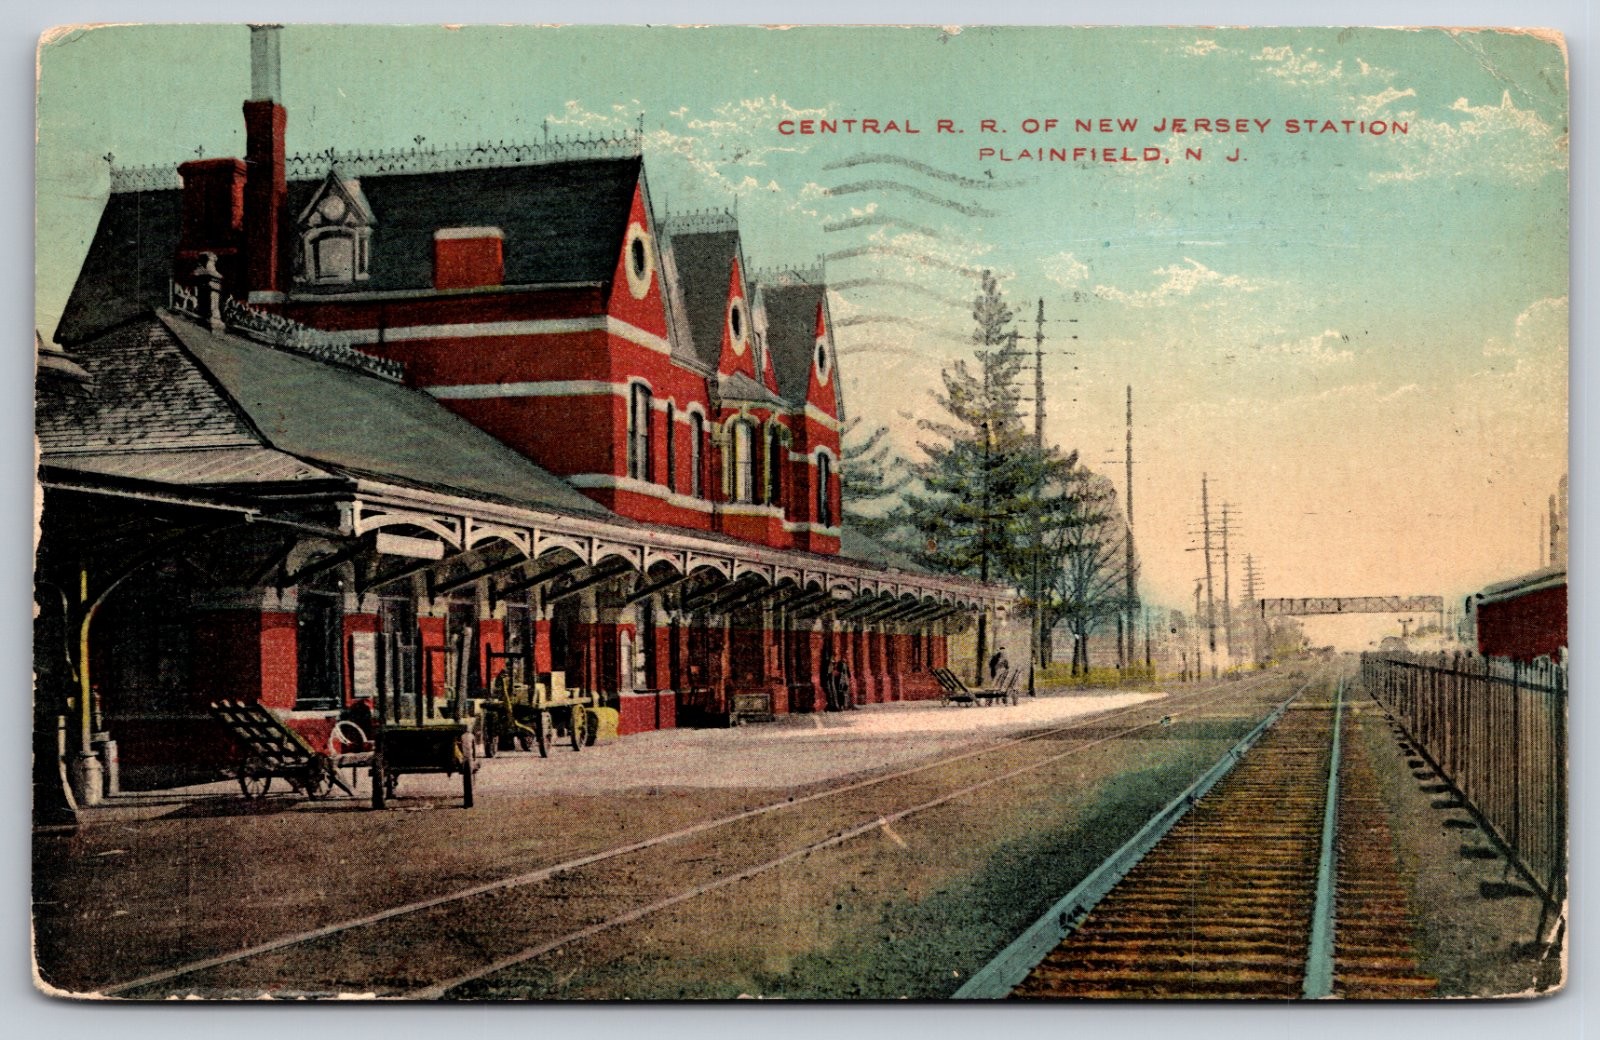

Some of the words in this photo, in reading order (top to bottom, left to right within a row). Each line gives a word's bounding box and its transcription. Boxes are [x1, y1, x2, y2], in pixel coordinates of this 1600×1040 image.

[777, 118, 921, 136] CENTRAL
[936, 118, 964, 135] R.
[979, 118, 1007, 134] R.
[1020, 118, 1059, 134] OF
[1074, 117, 1139, 134] NEW
[1152, 117, 1272, 134] JERSEY
[1284, 118, 1410, 136] STATION
[978, 146, 1171, 165] PLAINFIELD,
[1184, 146, 1203, 162] N
[1225, 147, 1249, 163] J.
